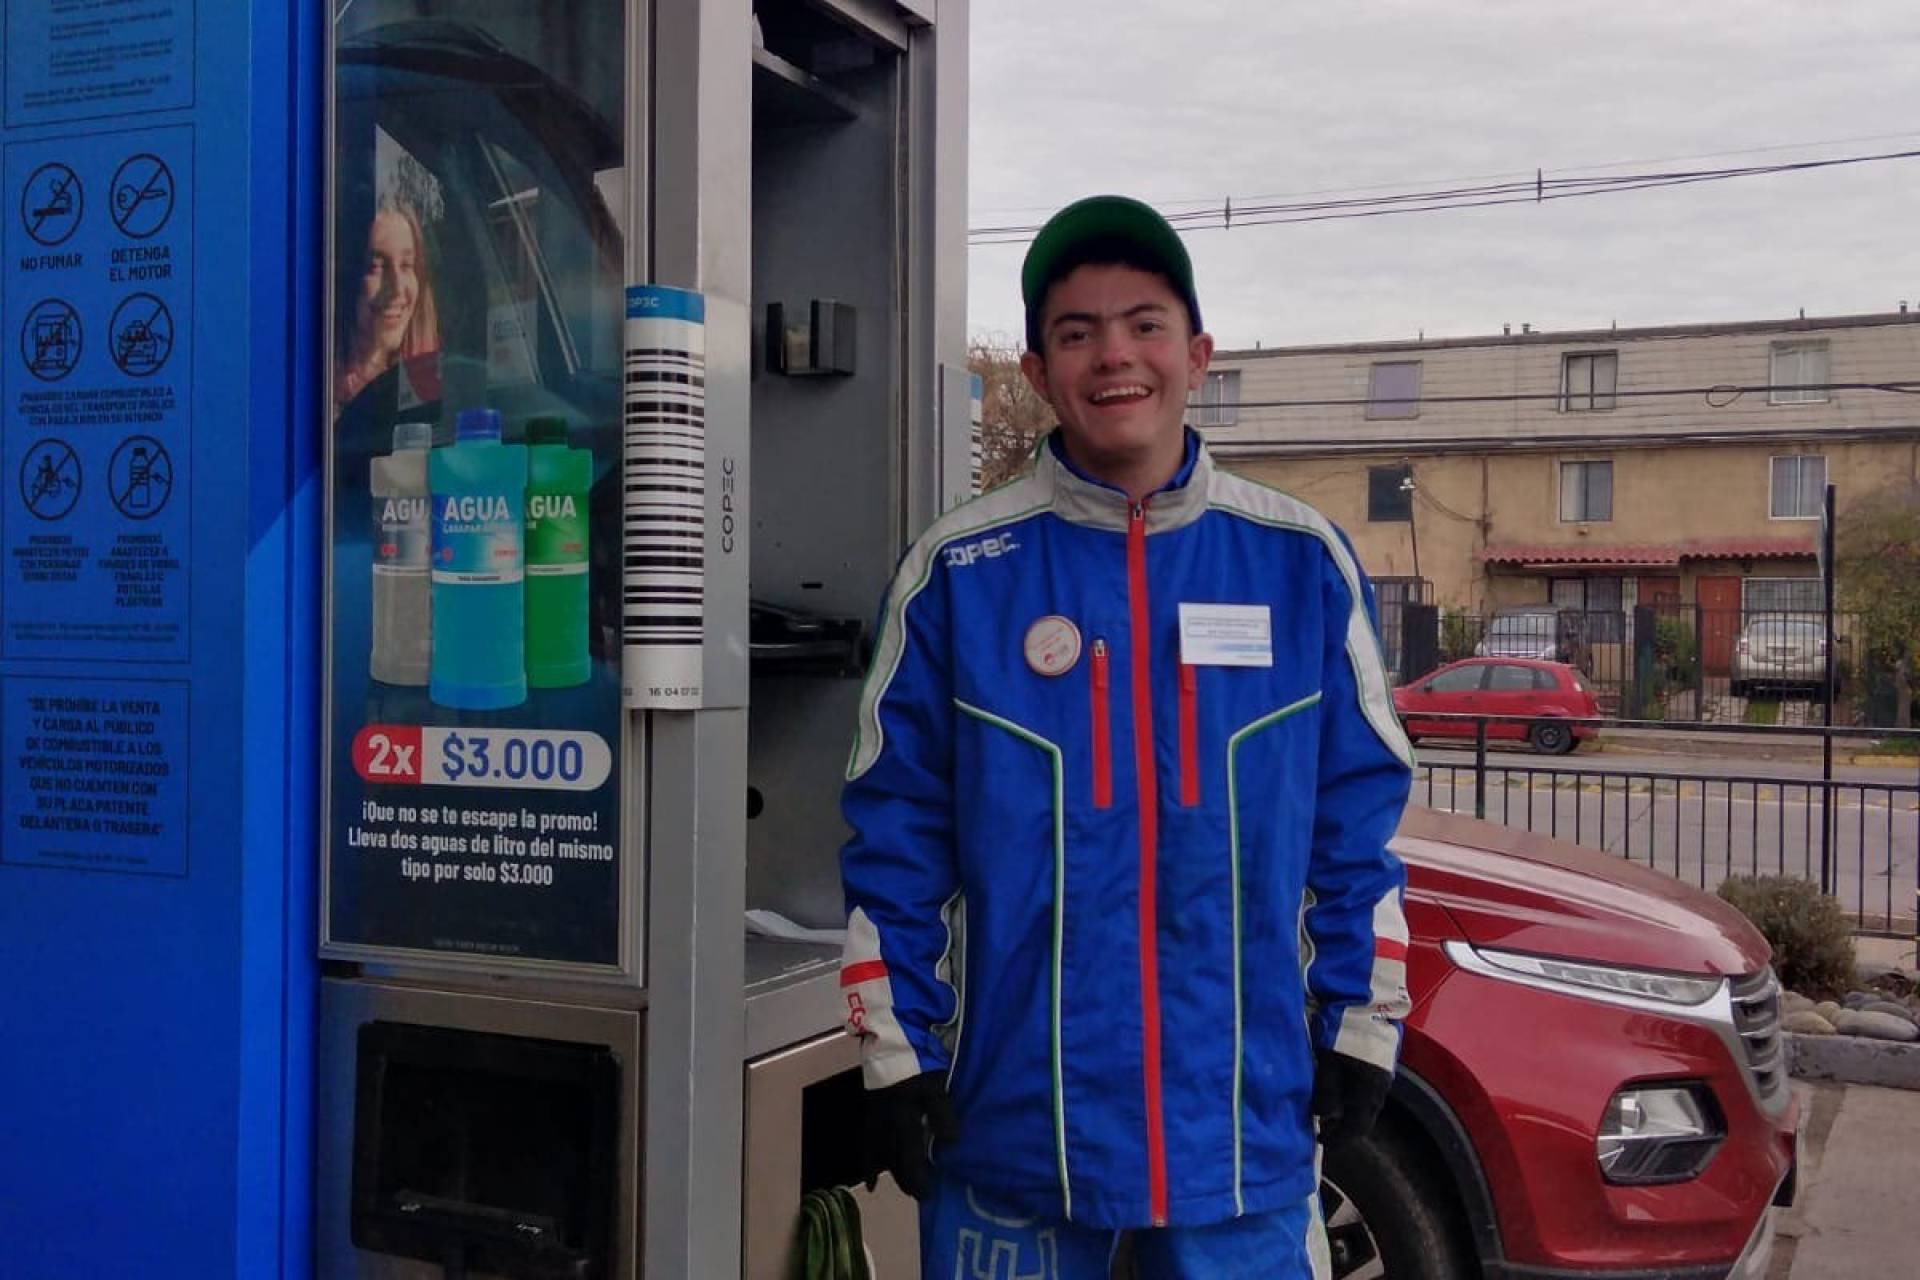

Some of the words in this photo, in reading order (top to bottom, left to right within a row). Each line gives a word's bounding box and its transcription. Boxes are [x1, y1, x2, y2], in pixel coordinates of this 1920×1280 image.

[20, 256, 38, 272] NO
[40, 253, 83, 270] FUMAR
[111, 246, 170, 263] DETENGA
[109, 267, 123, 283] EL
[128, 263, 172, 281] MOTOR
[382, 499, 430, 521] AGU
[444, 495, 510, 521] AGUA
[528, 495, 577, 518] GUA
[722, 457, 734, 553] COPEC
[102, 699, 118, 714] LA
[120, 700, 160, 716] VENTA
[33, 719, 40, 731] Y
[86, 719, 99, 734] AL
[138, 742, 162, 756] LOS
[367, 733, 416, 775] 2x
[441, 732, 583, 782] $3.000
[362, 800, 395, 823] ¡Que
[398, 807, 417, 823] no
[420, 807, 438, 823] se
[442, 806, 457, 824] te
[461, 809, 518, 831] escape
[521, 808, 537, 829] la
[540, 811, 598, 833] promo!
[348, 827, 387, 848] Lleva
[390, 829, 418, 849] dos
[421, 834, 467, 856] aguas
[471, 833, 489, 854] de
[493, 833, 526, 856] litro
[530, 836, 554, 857] del
[558, 838, 613, 861] mismo
[401, 857, 430, 881] tipo
[434, 862, 460, 883] por
[463, 861, 496, 882] solo
[500, 862, 553, 885] $3.000
